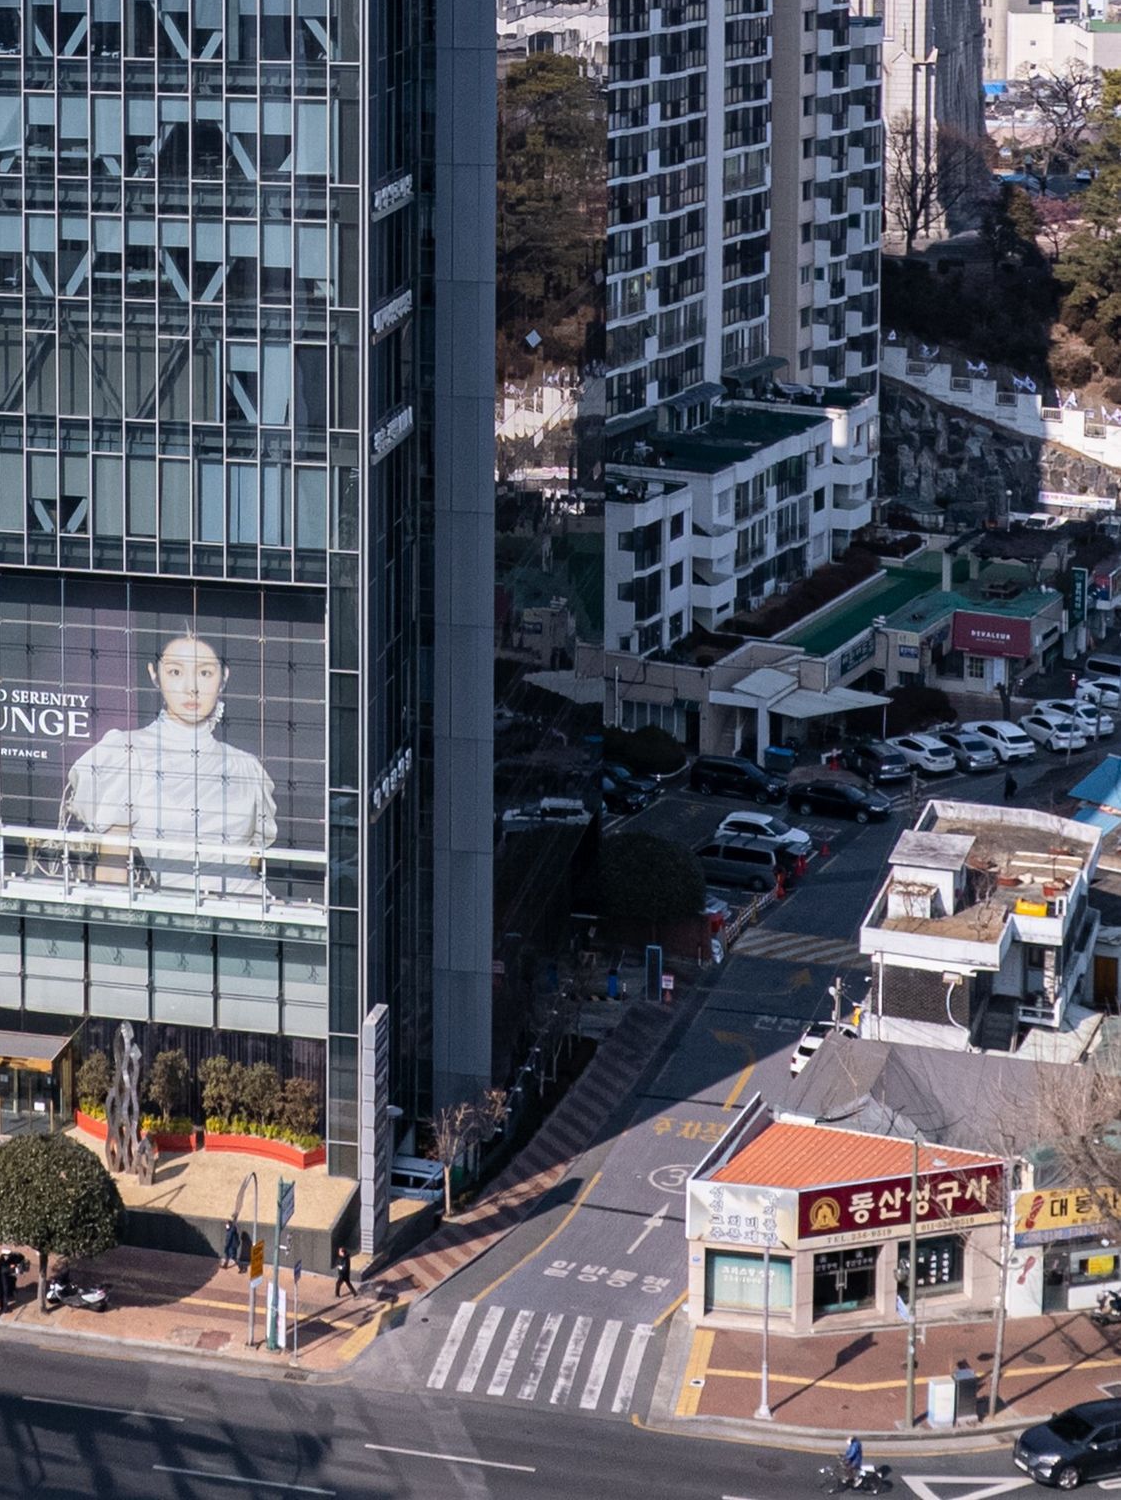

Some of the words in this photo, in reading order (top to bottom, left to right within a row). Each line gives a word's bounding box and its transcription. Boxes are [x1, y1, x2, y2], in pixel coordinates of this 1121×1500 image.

[970, 629, 1012, 640] DEVALEUR
[11, 689, 90, 708] SERENITY
[653, 1116, 728, 1142] 주차장
[848, 1174, 991, 1224] 동산성구사
[543, 1259, 671, 1294] 일방통행
